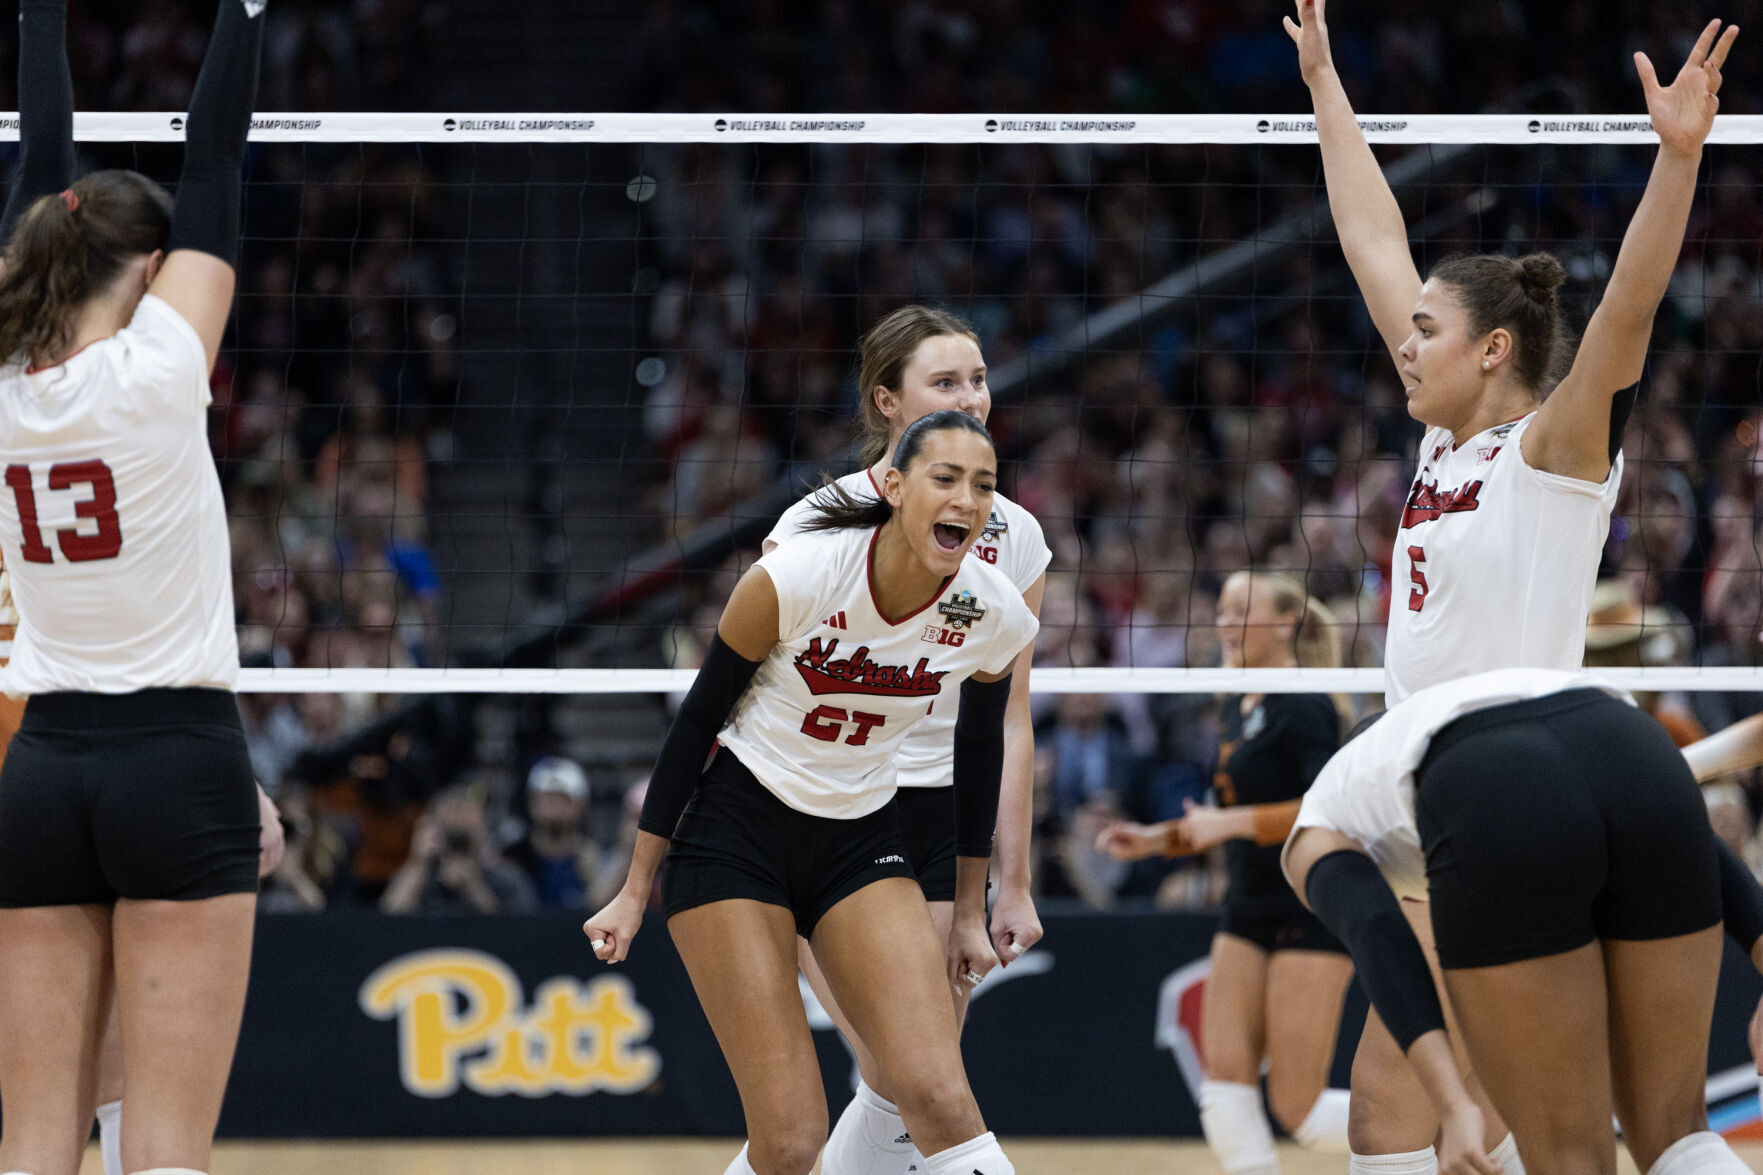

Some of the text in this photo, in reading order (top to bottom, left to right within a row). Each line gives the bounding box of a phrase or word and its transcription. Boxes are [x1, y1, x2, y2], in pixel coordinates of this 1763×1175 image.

[459, 120, 595, 130] VOLLEYBALL CHAMPIONSHIP
[730, 120, 866, 130] VOLLEYBALL CHAMPIONSHIP
[1001, 121, 1136, 131] VOLLEYBALL CHAMPIONSHIP
[1272, 121, 1408, 131] VOLLEYBA PIONSHIP
[1543, 121, 1654, 132] VOLLEYBALL CHAMPION
[4, 458, 123, 564] 13
[1407, 545, 1429, 612] 5
[941, 606, 982, 618] CHAMPIONSHIP
[358, 948, 661, 1097] Pitt
